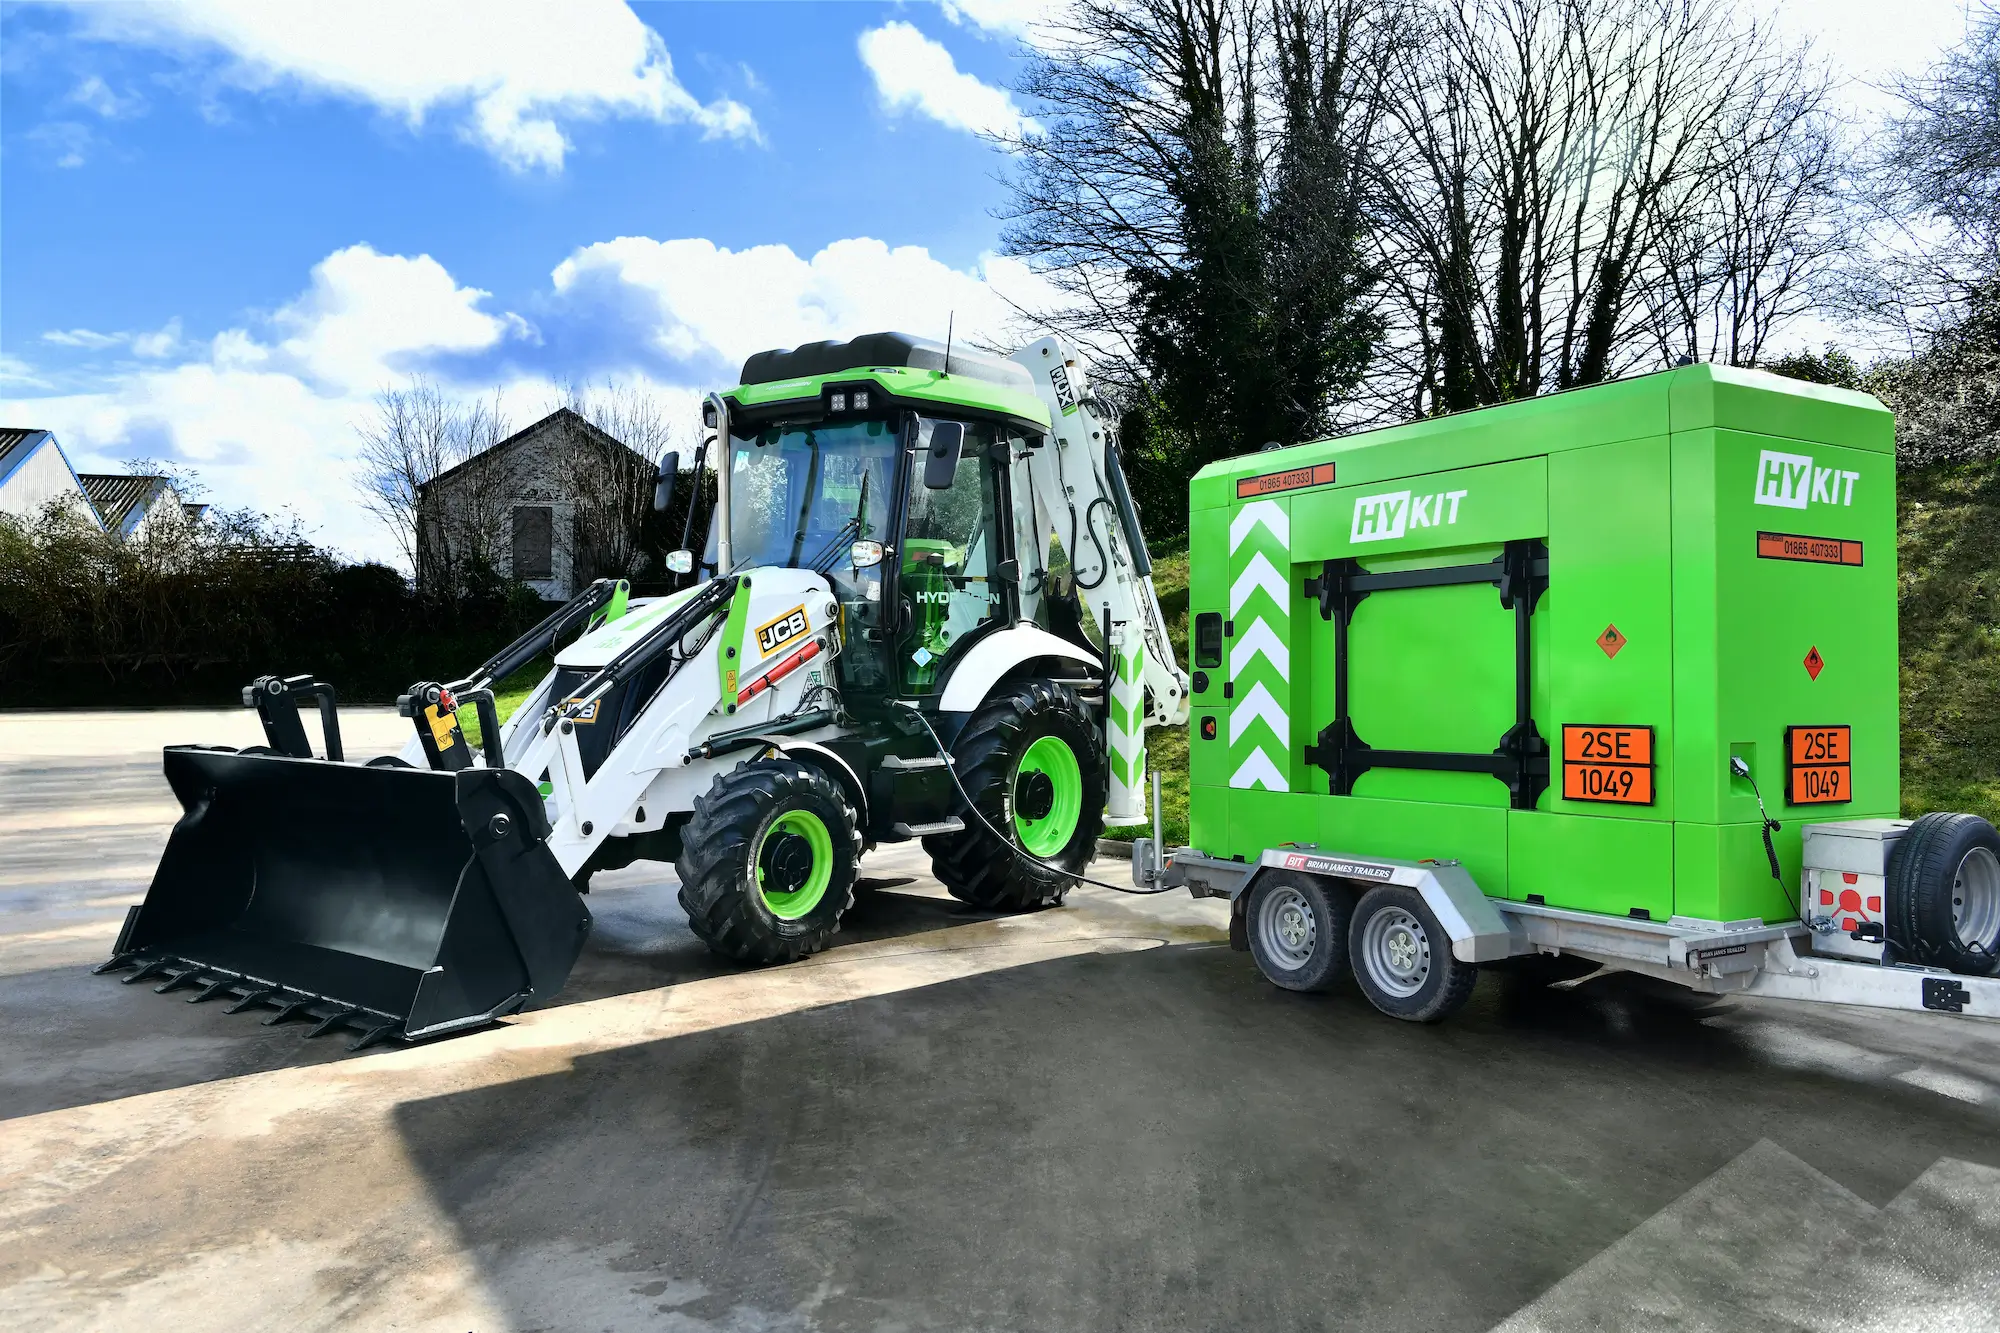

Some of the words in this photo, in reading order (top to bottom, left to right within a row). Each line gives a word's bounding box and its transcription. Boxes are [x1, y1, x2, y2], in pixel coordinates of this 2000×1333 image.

[1260, 477, 1280, 490] 01865
[1282, 472, 1310, 486] 407333
[1784, 540, 1808, 556] 01865
[1810, 543, 1839, 558] 407333
[762, 612, 806, 650] JCB
[1581, 731, 1631, 759] 2SE
[1804, 732, 1838, 760] 2SE
[1579, 768, 1634, 798] 1049
[1803, 770, 1839, 798] 1049
[1307, 860, 1329, 870] BRIAN
[1328, 863, 1353, 873] JAMES
[1354, 866, 1391, 878] TRAILERS
